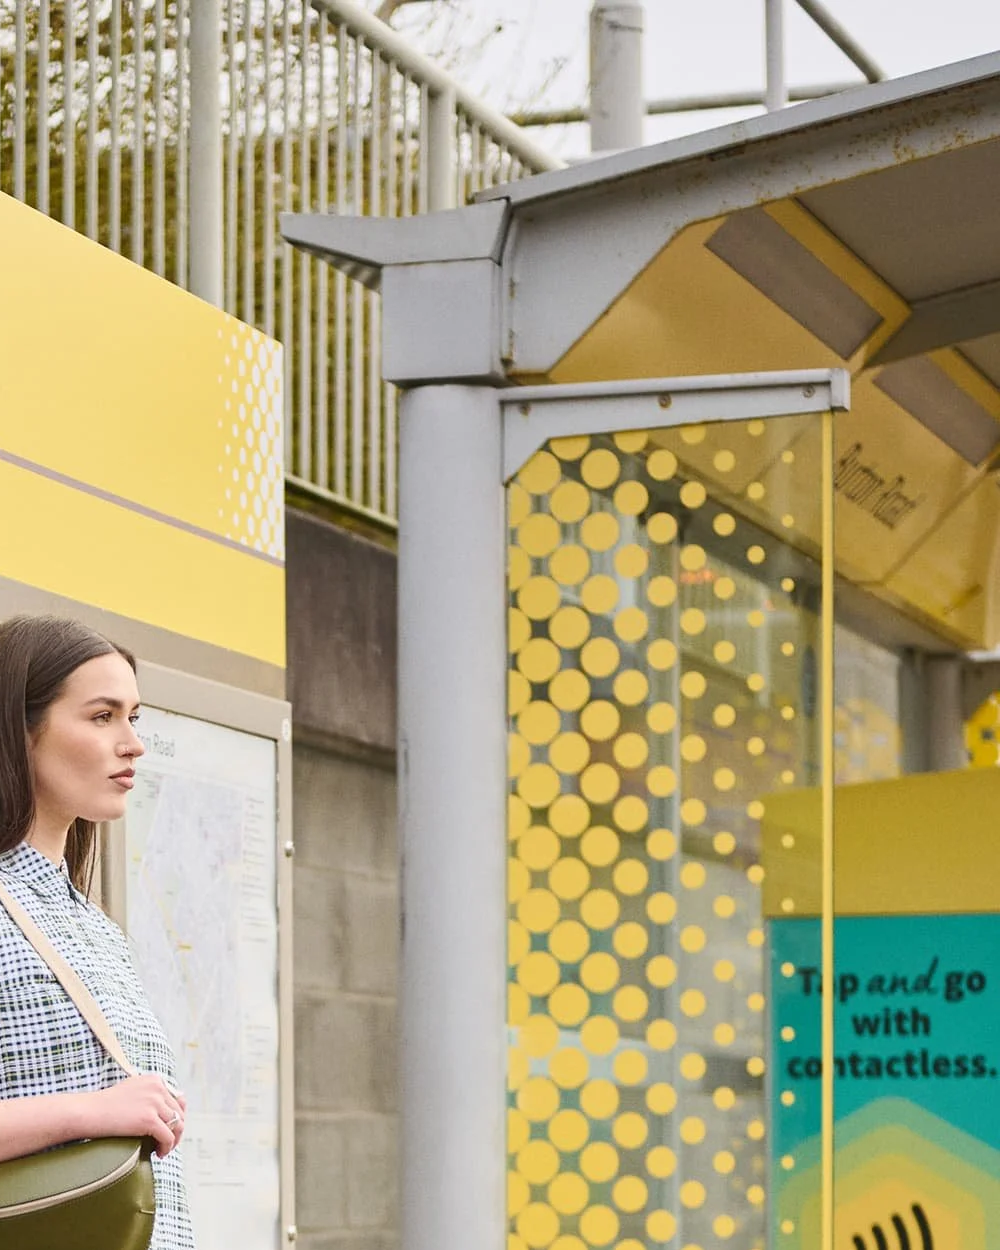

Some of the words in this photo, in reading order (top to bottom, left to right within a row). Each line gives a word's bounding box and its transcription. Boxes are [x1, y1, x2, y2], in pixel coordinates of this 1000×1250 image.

[867, 955, 939, 995] and
[945, 970, 987, 1003] go
[852, 1007, 932, 1037] with
